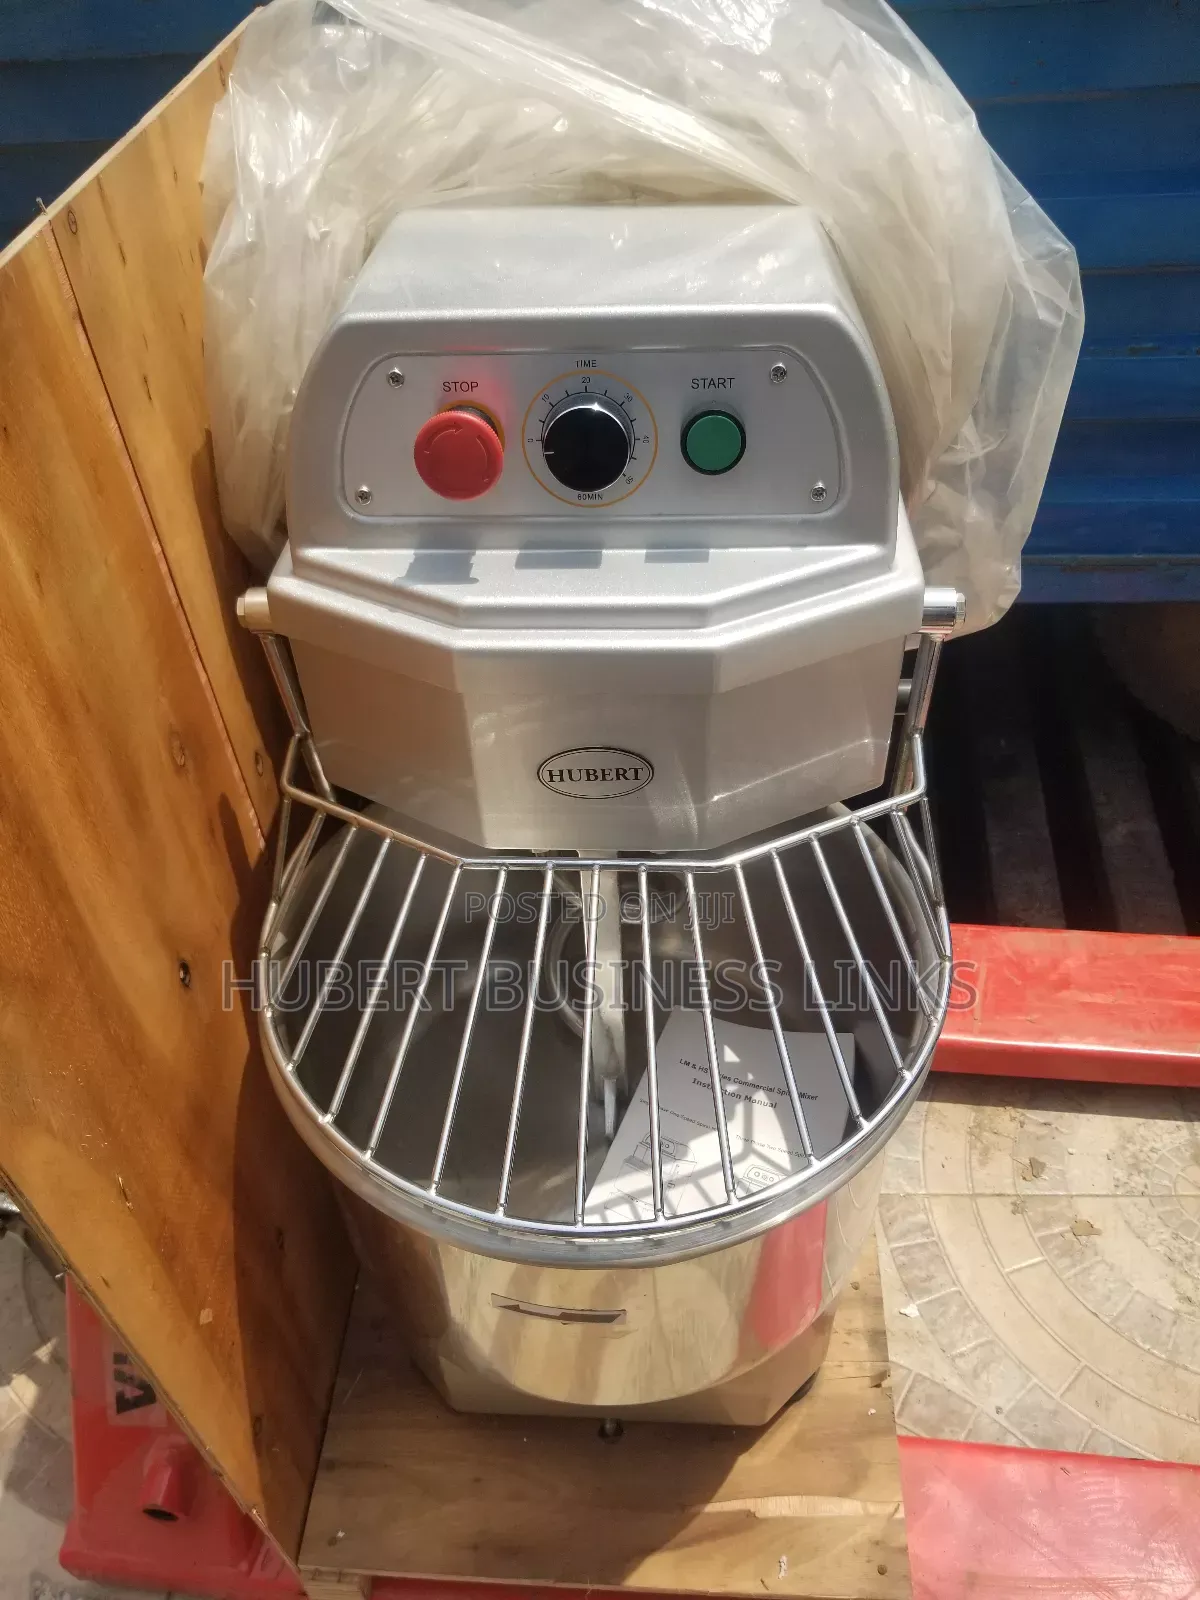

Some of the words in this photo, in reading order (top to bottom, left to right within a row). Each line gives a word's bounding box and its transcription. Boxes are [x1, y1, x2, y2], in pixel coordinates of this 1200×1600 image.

[575, 359, 597, 368] TIME
[581, 376, 591, 384] 20
[691, 377, 736, 390] START
[442, 381, 479, 393] STOP
[577, 493, 604, 501] 60MIN
[546, 767, 644, 783] HUBERT
[679, 1058, 691, 1067] LM
[698, 1065, 709, 1074] HS
[733, 1077, 776, 1093] Commercial
[692, 1077, 742, 1100] Insttion
[744, 1094, 778, 1109] Manual
